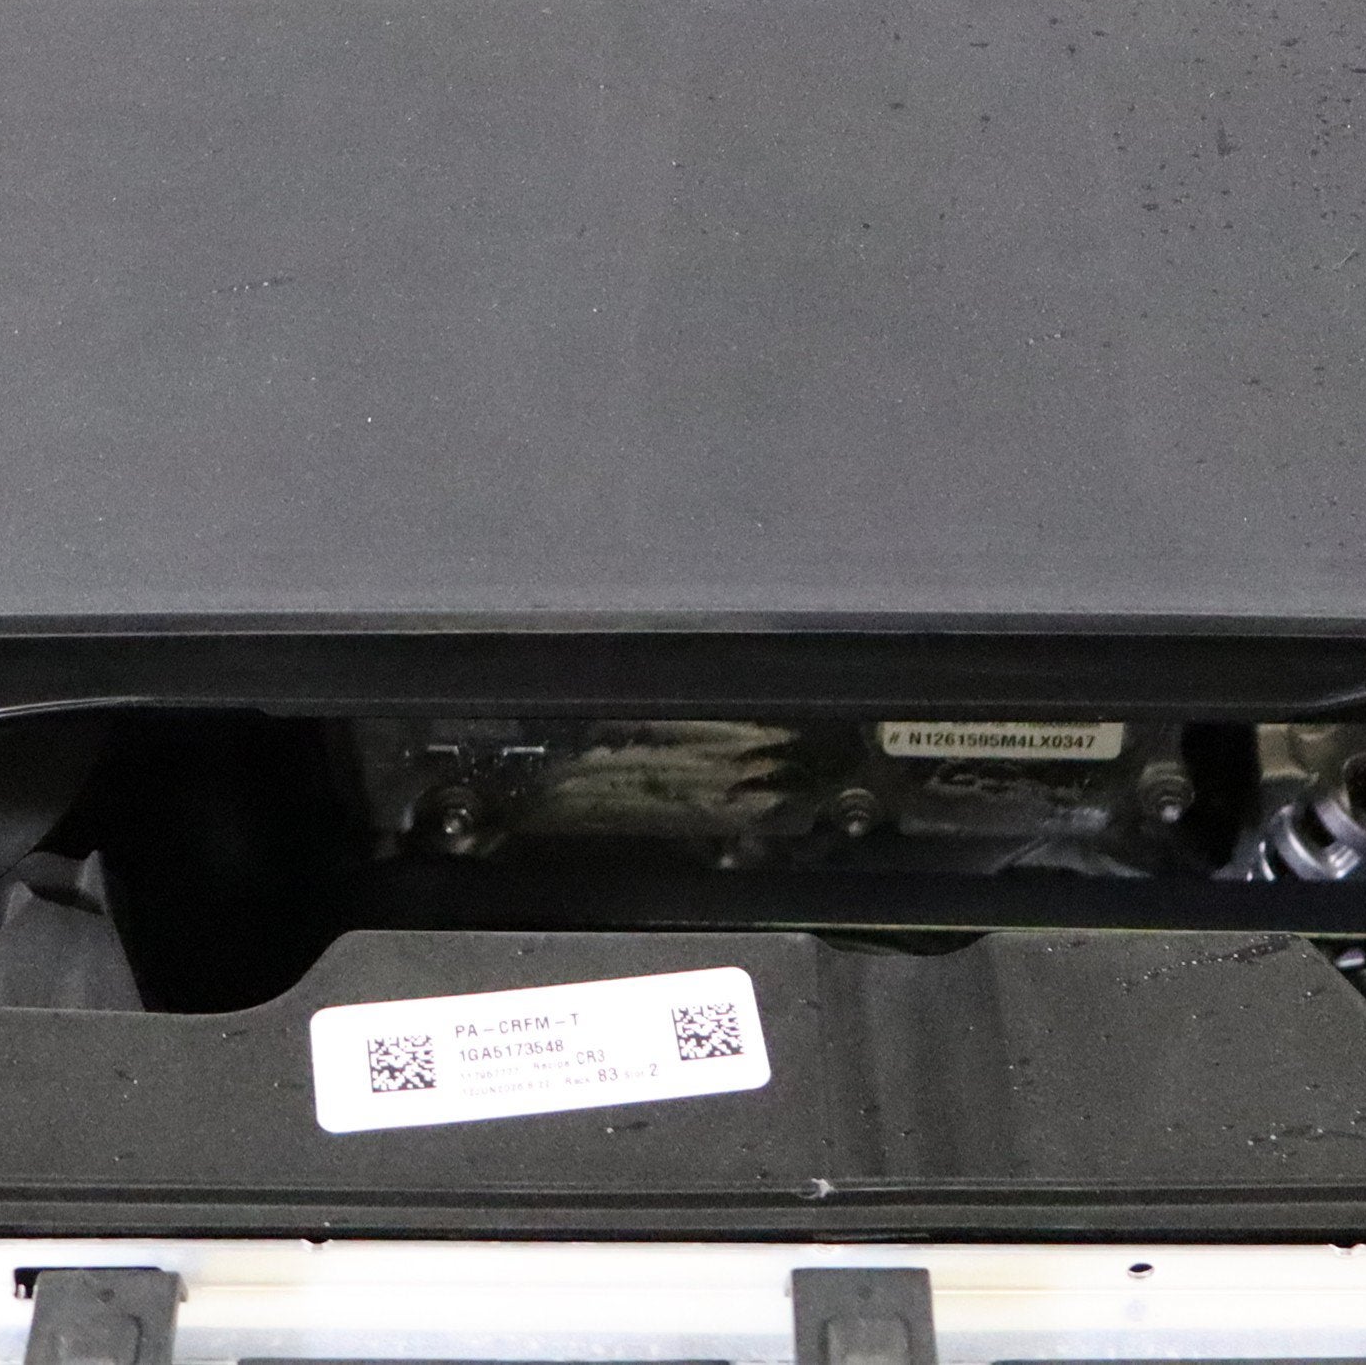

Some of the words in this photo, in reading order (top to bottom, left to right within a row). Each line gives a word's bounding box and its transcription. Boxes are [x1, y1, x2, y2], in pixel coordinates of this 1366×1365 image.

[459, 1039, 564, 1062] 1GA5173548
[576, 1049, 606, 1065] CR3
[597, 1067, 619, 1083] 83
[649, 1063, 659, 1077] 2
